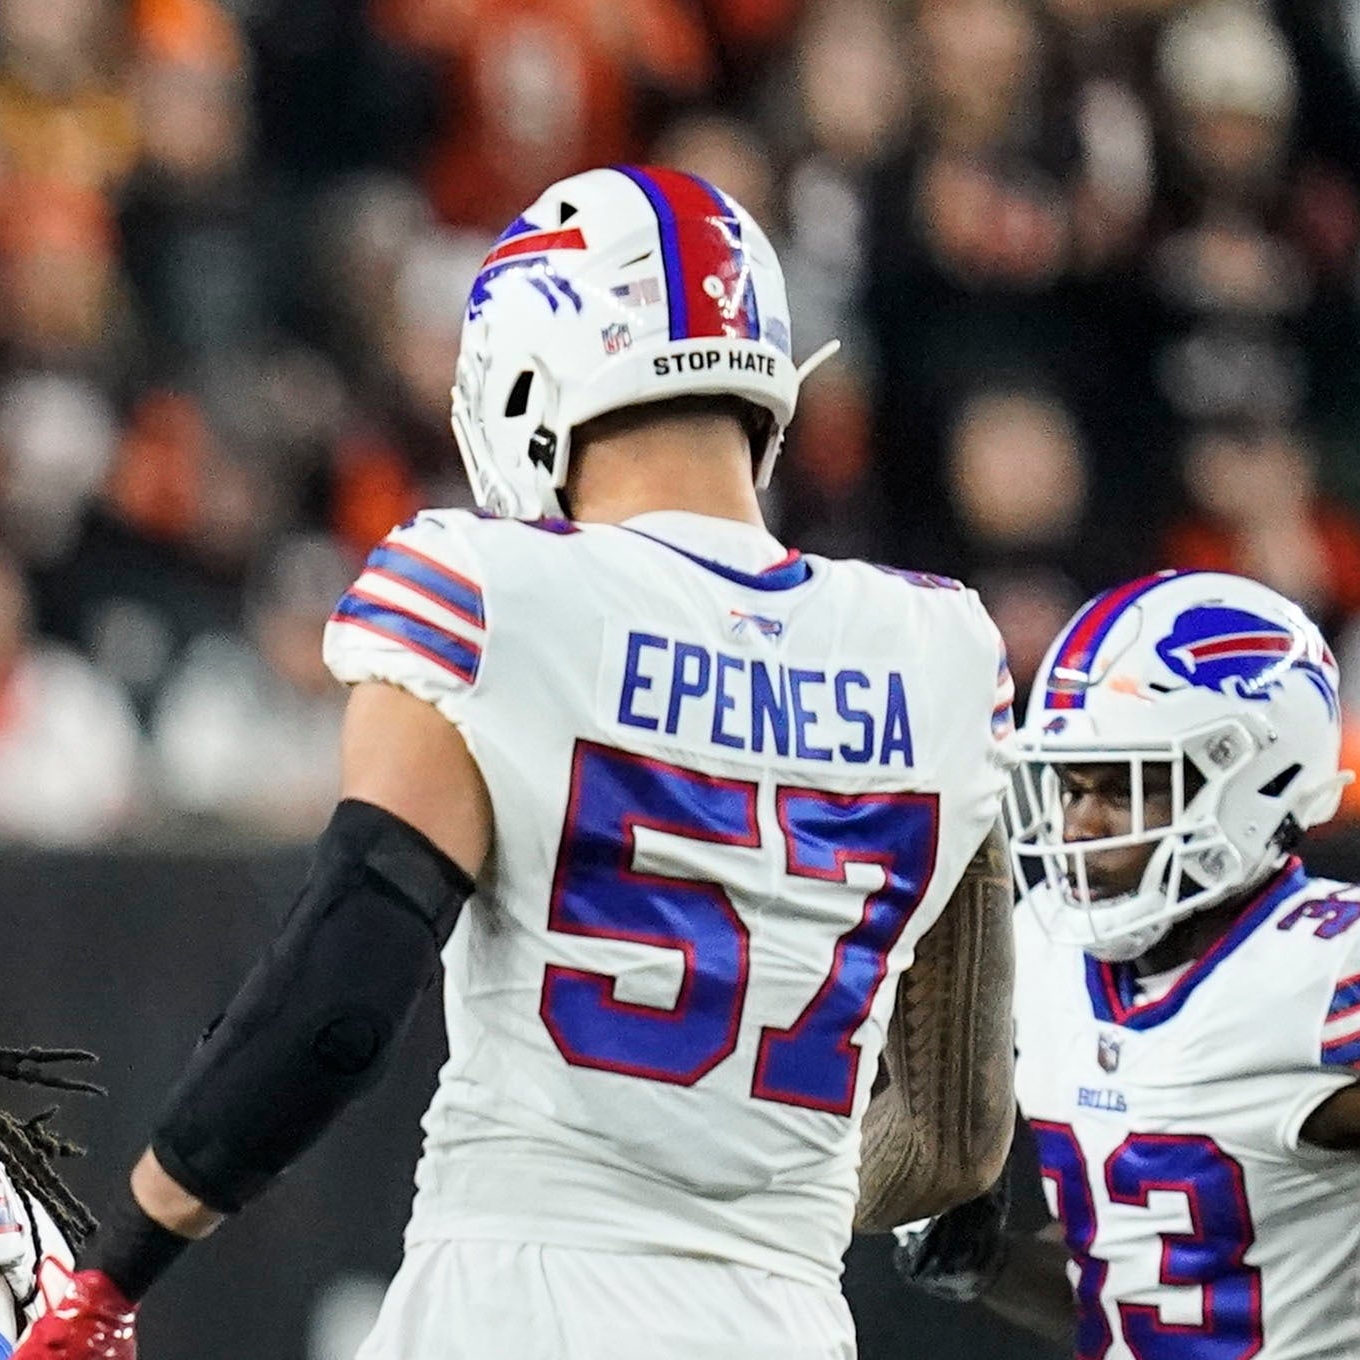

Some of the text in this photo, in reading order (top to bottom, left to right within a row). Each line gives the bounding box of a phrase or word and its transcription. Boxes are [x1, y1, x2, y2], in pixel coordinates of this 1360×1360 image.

[653, 350, 776, 377] STOP HATE
[617, 630, 916, 769] EPENESA
[539, 738, 941, 1117] 57
